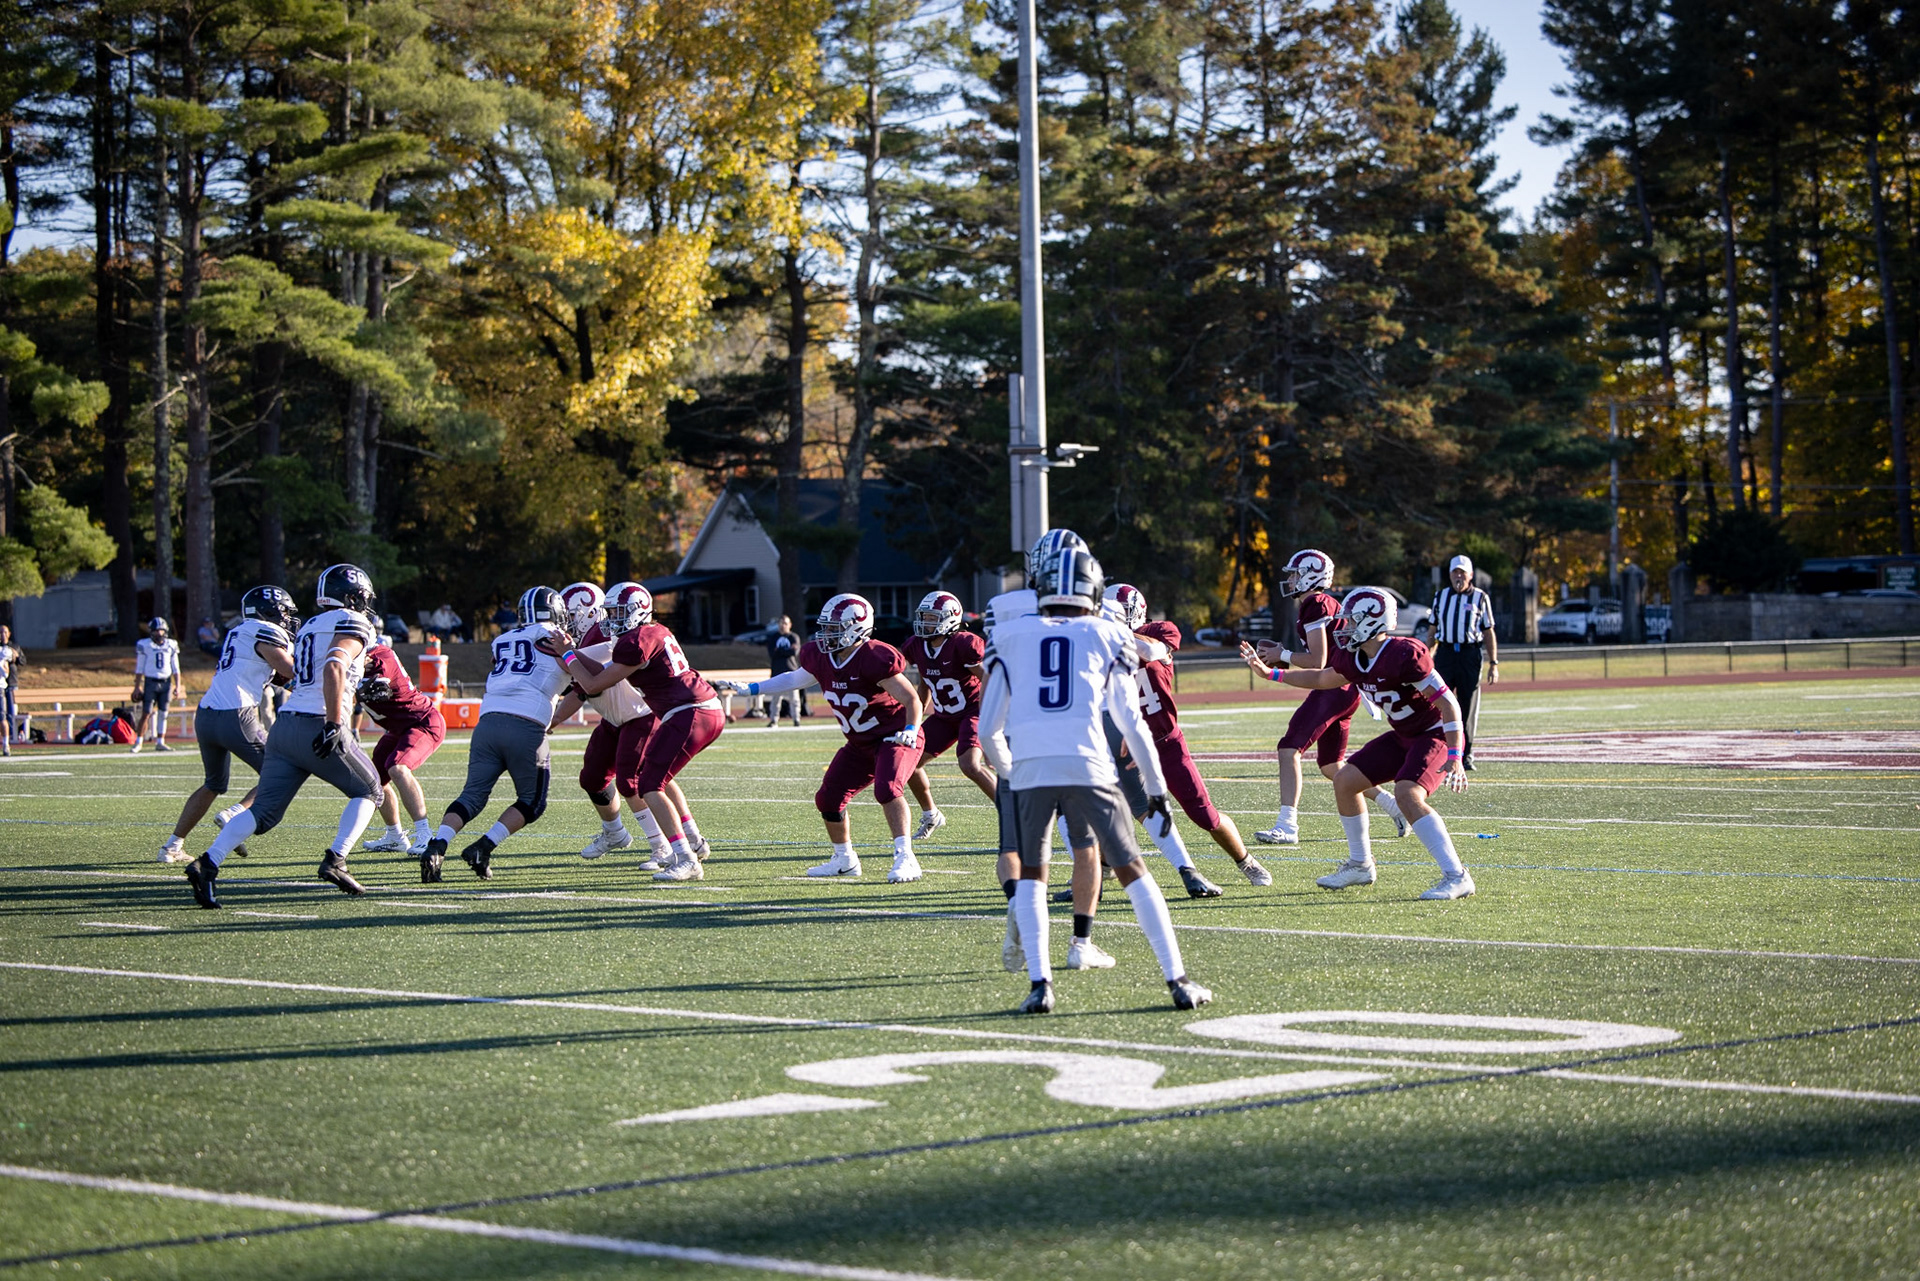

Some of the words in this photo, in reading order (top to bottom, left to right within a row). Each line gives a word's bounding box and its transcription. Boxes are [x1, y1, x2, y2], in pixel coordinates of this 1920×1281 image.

[263, 588, 282, 601] 55
[155, 652, 165, 670] 8
[216, 631, 239, 672] 5
[490, 639, 537, 677] 53
[663, 634, 690, 676] 6
[832, 681, 848, 690] RAMS
[1039, 636, 1074, 712] 9
[459, 705, 470, 718] G
[823, 690, 879, 733] 62
[1364, 690, 1415, 720] 2
